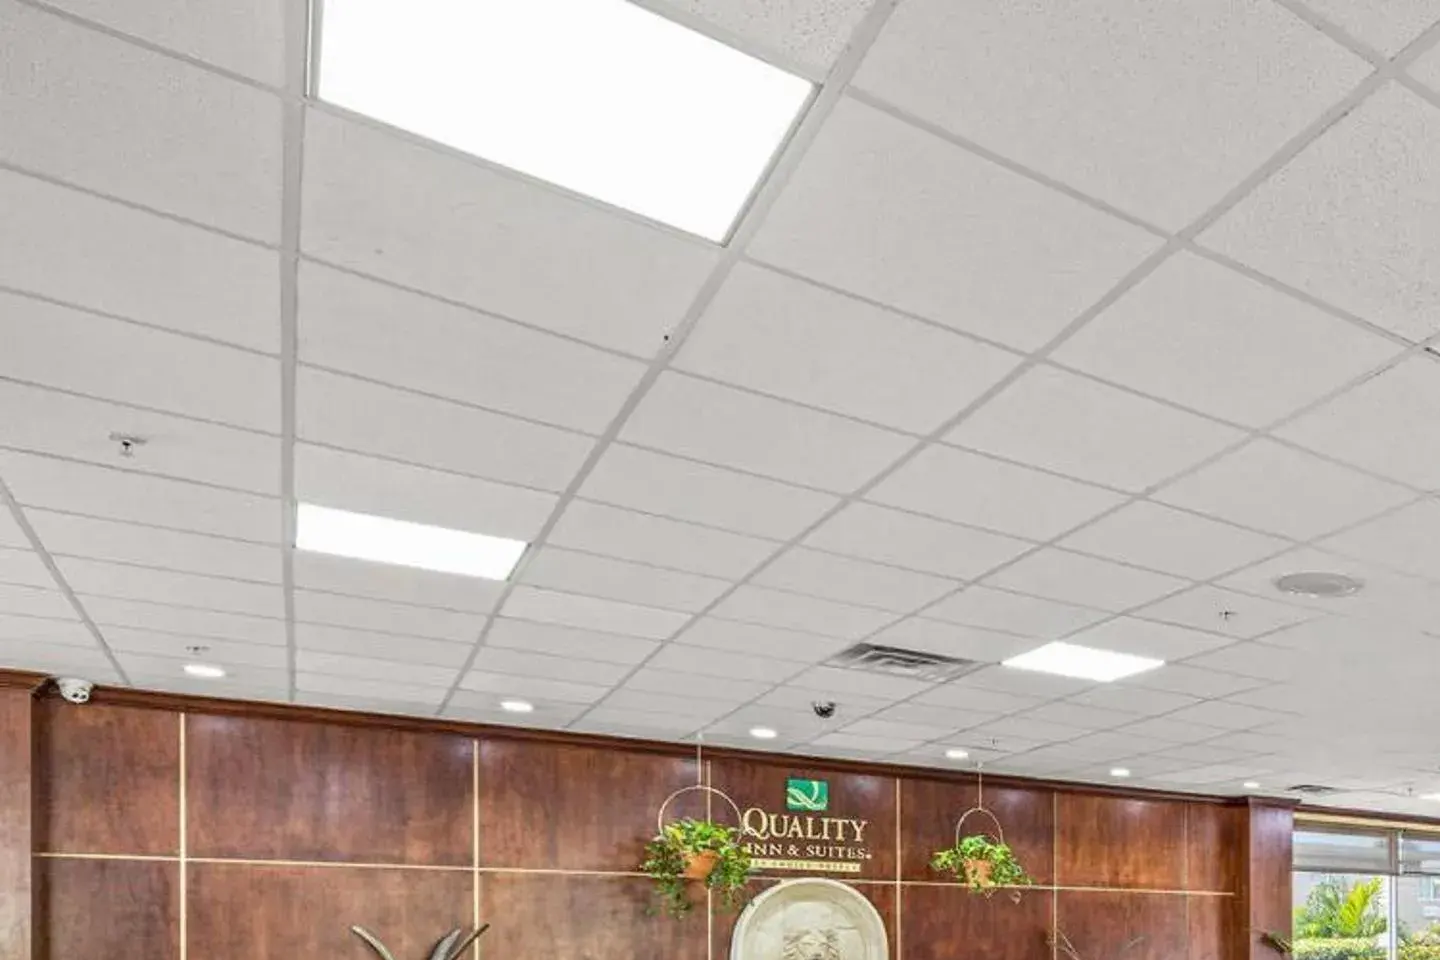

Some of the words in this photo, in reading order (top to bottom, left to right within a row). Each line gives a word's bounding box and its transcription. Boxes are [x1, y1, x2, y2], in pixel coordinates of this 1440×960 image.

[742, 807, 868, 842] QUALITY
[747, 842, 783, 855] INN
[786, 843, 800, 857] &
